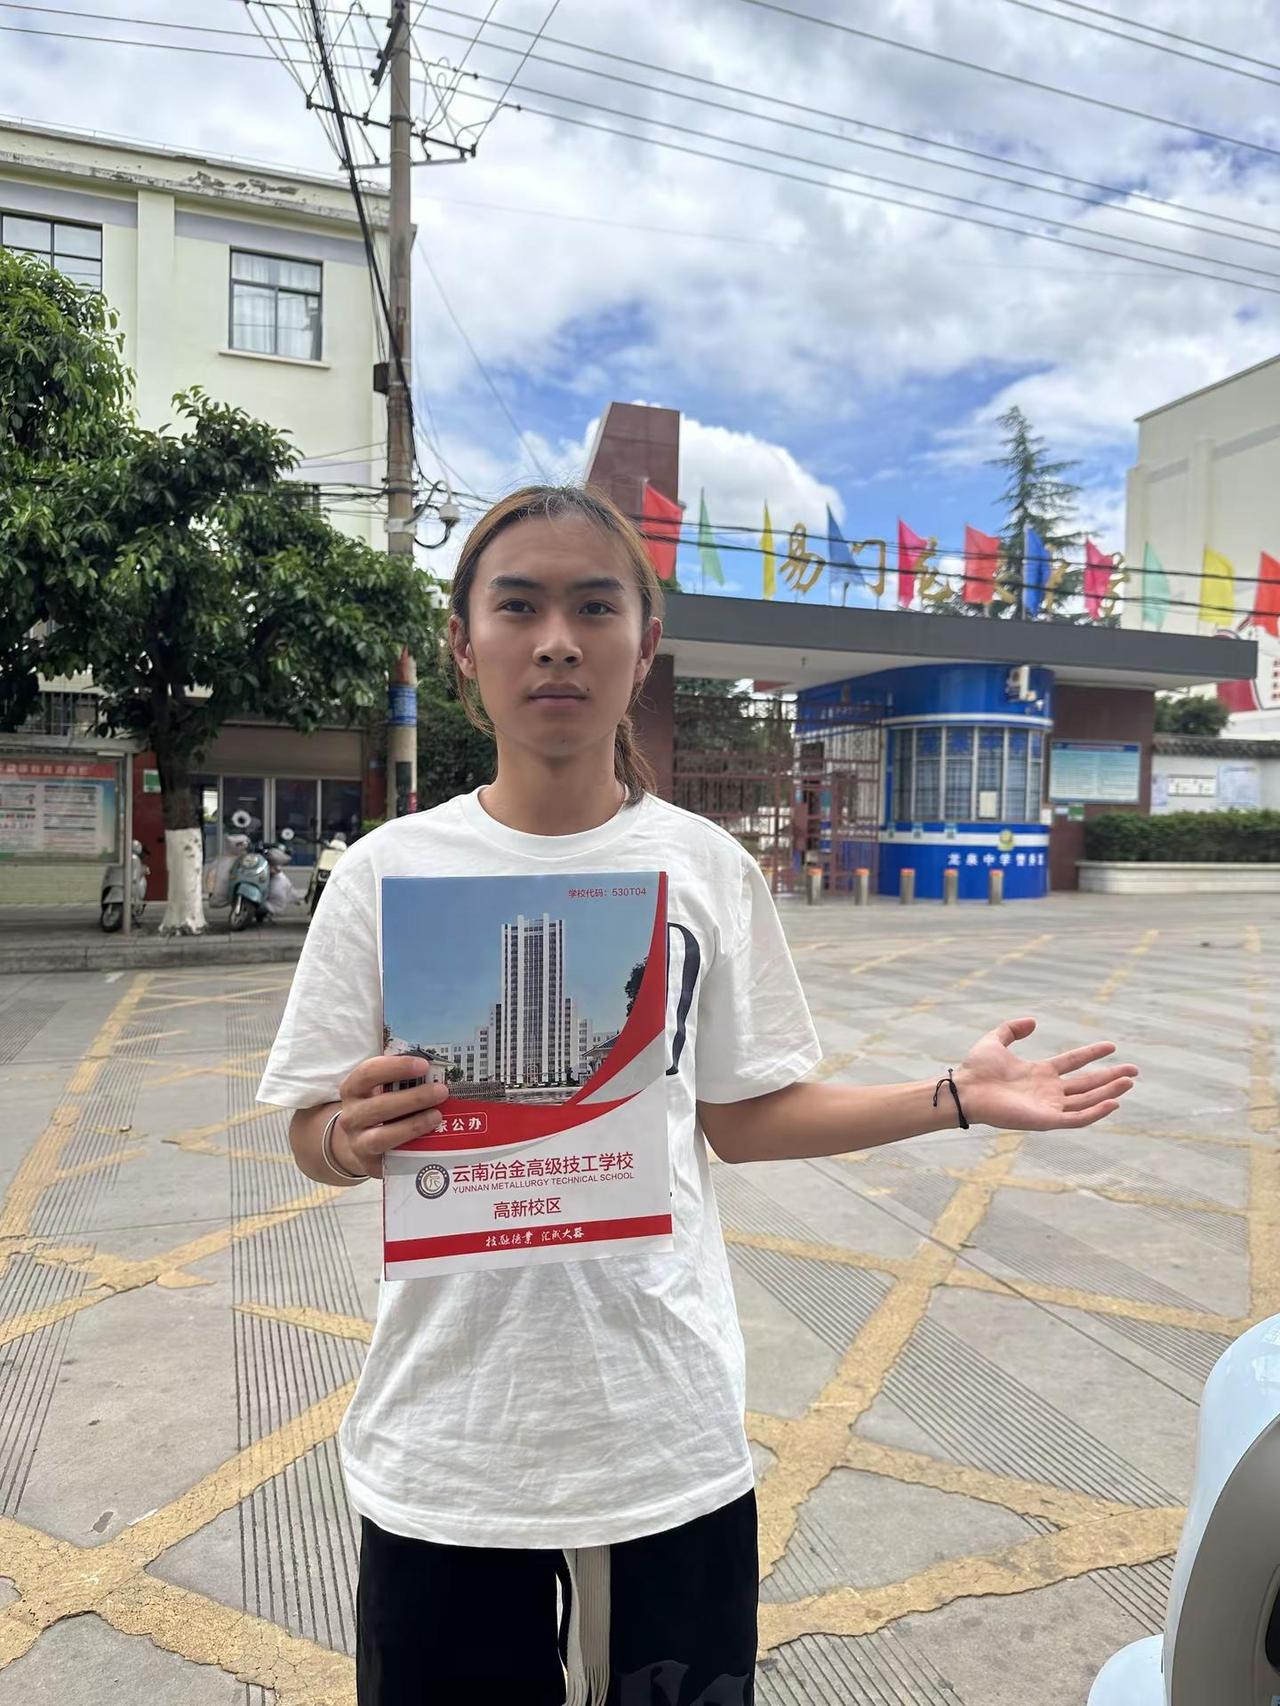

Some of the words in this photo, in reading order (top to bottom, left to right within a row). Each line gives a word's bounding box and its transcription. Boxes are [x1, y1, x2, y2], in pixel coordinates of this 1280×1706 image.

[452, 1152, 634, 1183] 云南冶金高级技工学校
[452, 1183, 490, 1194] YUNNAN
[491, 1178, 549, 1190] METALLURGY
[551, 1174, 598, 1185] TECHNICAL
[600, 1172, 635, 1182] SCHOOL
[493, 1197, 562, 1219] 高新校区
